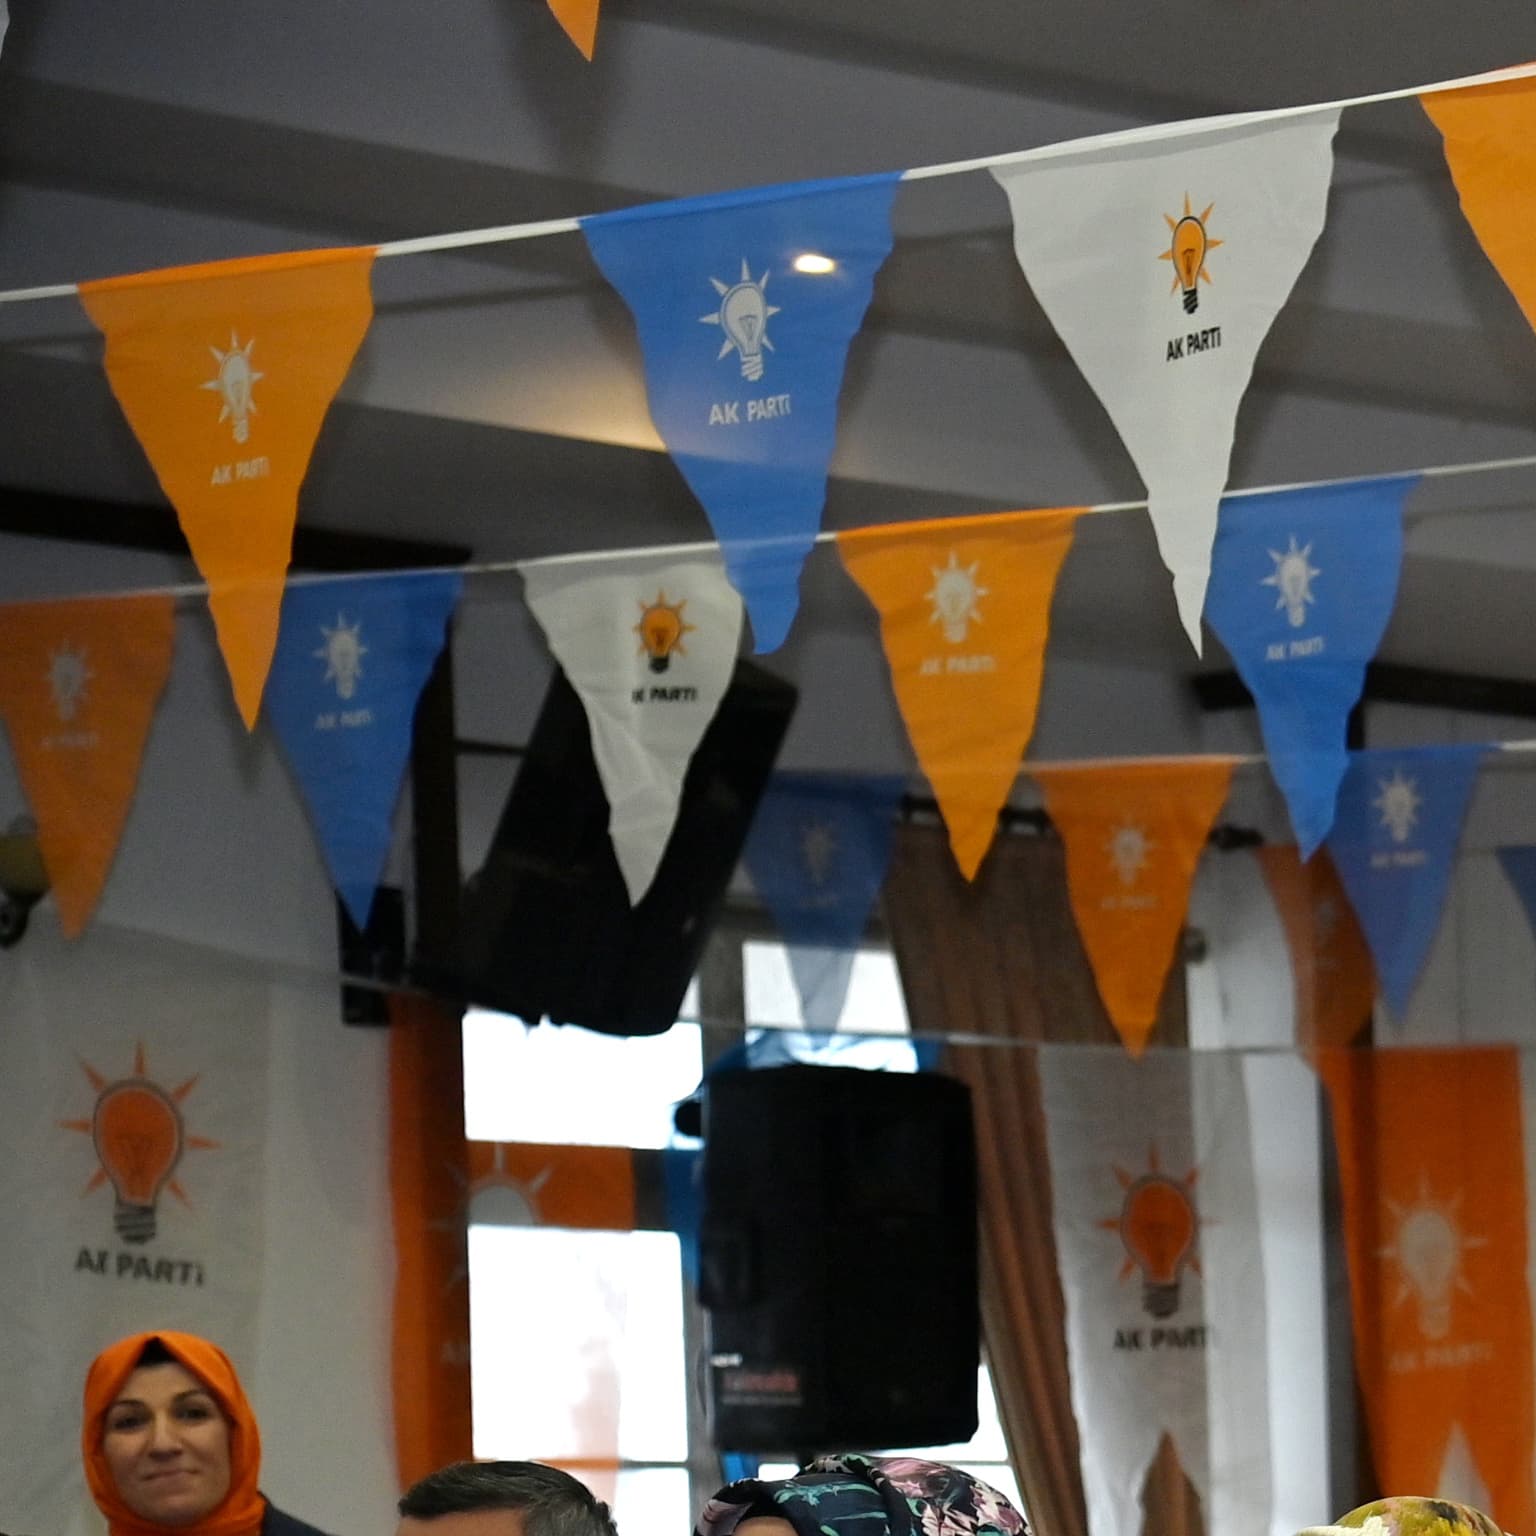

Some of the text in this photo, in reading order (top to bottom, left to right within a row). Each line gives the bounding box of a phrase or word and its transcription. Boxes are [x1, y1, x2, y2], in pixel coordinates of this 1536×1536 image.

[1166, 335, 1184, 362] AK
[709, 401, 739, 426] AK
[211, 460, 231, 486] AK
